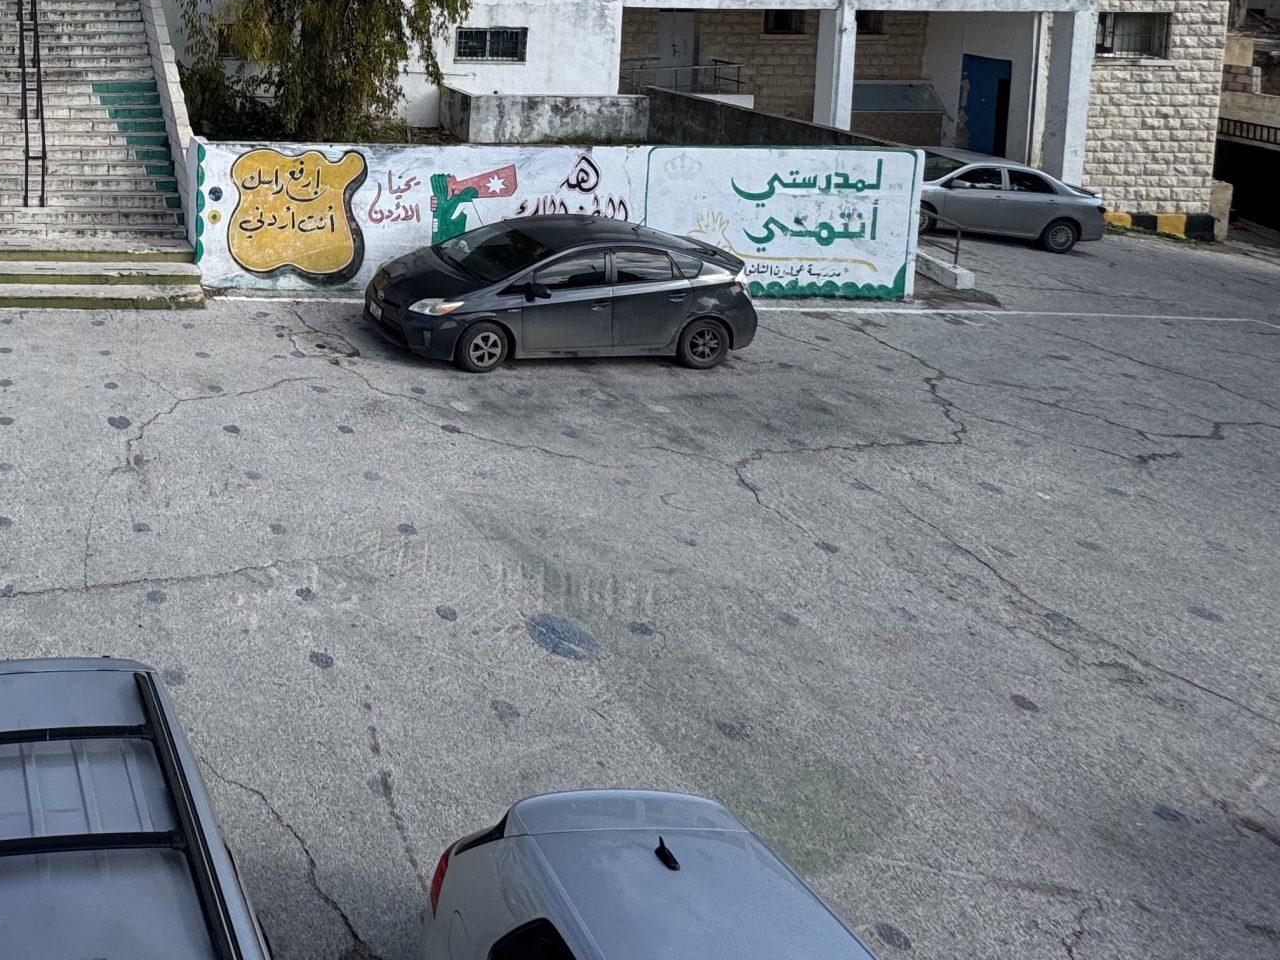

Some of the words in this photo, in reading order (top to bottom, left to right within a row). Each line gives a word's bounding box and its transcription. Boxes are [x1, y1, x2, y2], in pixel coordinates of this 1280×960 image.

[730, 158, 884, 208] لمدرستي
[742, 198, 880, 252] أنتمي
[806, 263, 841, 278] مدرسة
